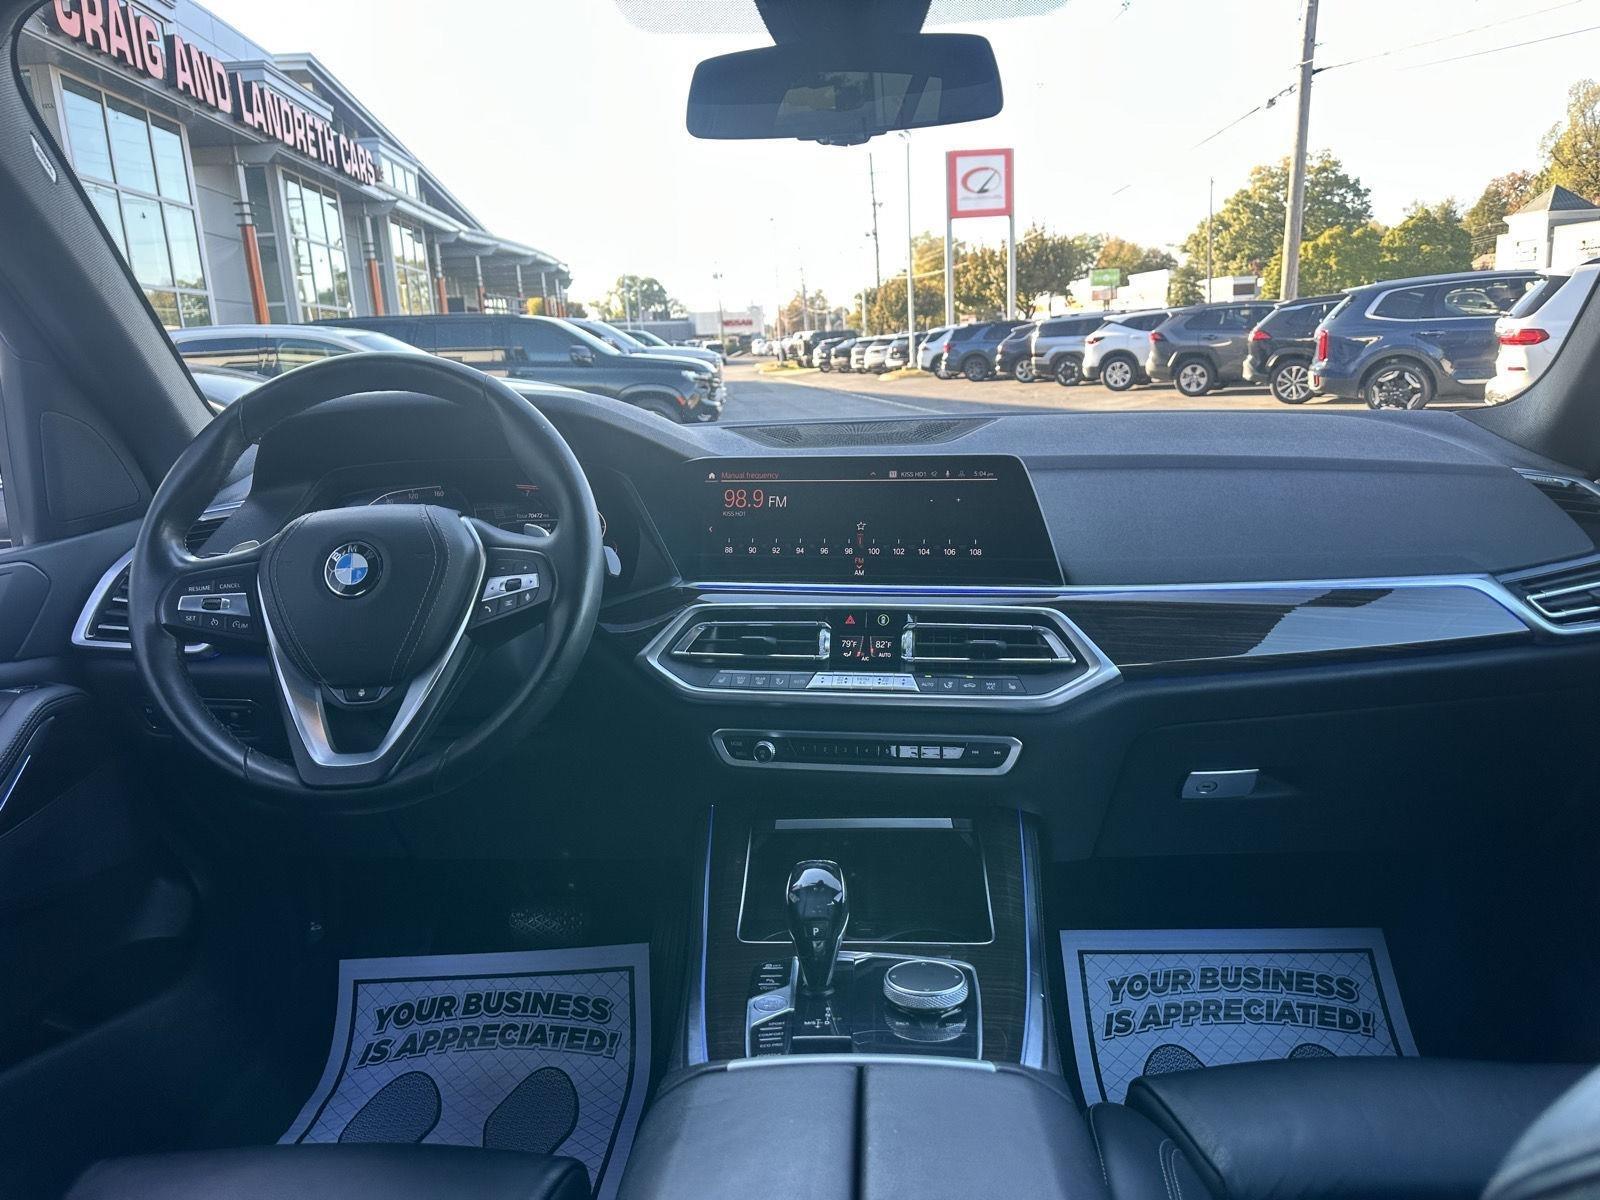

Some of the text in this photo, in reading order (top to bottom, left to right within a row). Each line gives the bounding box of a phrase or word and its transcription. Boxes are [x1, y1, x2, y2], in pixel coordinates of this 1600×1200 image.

[54, 0, 376, 186] CRAIG AND LANDRETH CARS
[721, 471, 779, 481] Manual frequency
[408, 492, 419, 500] 120
[724, 489, 787, 508] 98.9 FM
[724, 546, 733, 554] 88
[748, 546, 757, 554] 90
[771, 546, 781, 554] 92
[795, 547, 805, 555] 94
[820, 547, 829, 555] 96
[893, 548, 905, 556] 102
[918, 548, 930, 556] 104
[943, 548, 956, 556] 106
[969, 548, 982, 556] 108
[813, 928, 819, 936] P
[1106, 965, 1360, 1004] YOUR BUSINESS
[373, 990, 612, 1034] YOUR BUSINESS
[1102, 998, 1375, 1039] IS APPRECIATED!
[354, 1022, 621, 1068] IS APPRECIATED!
